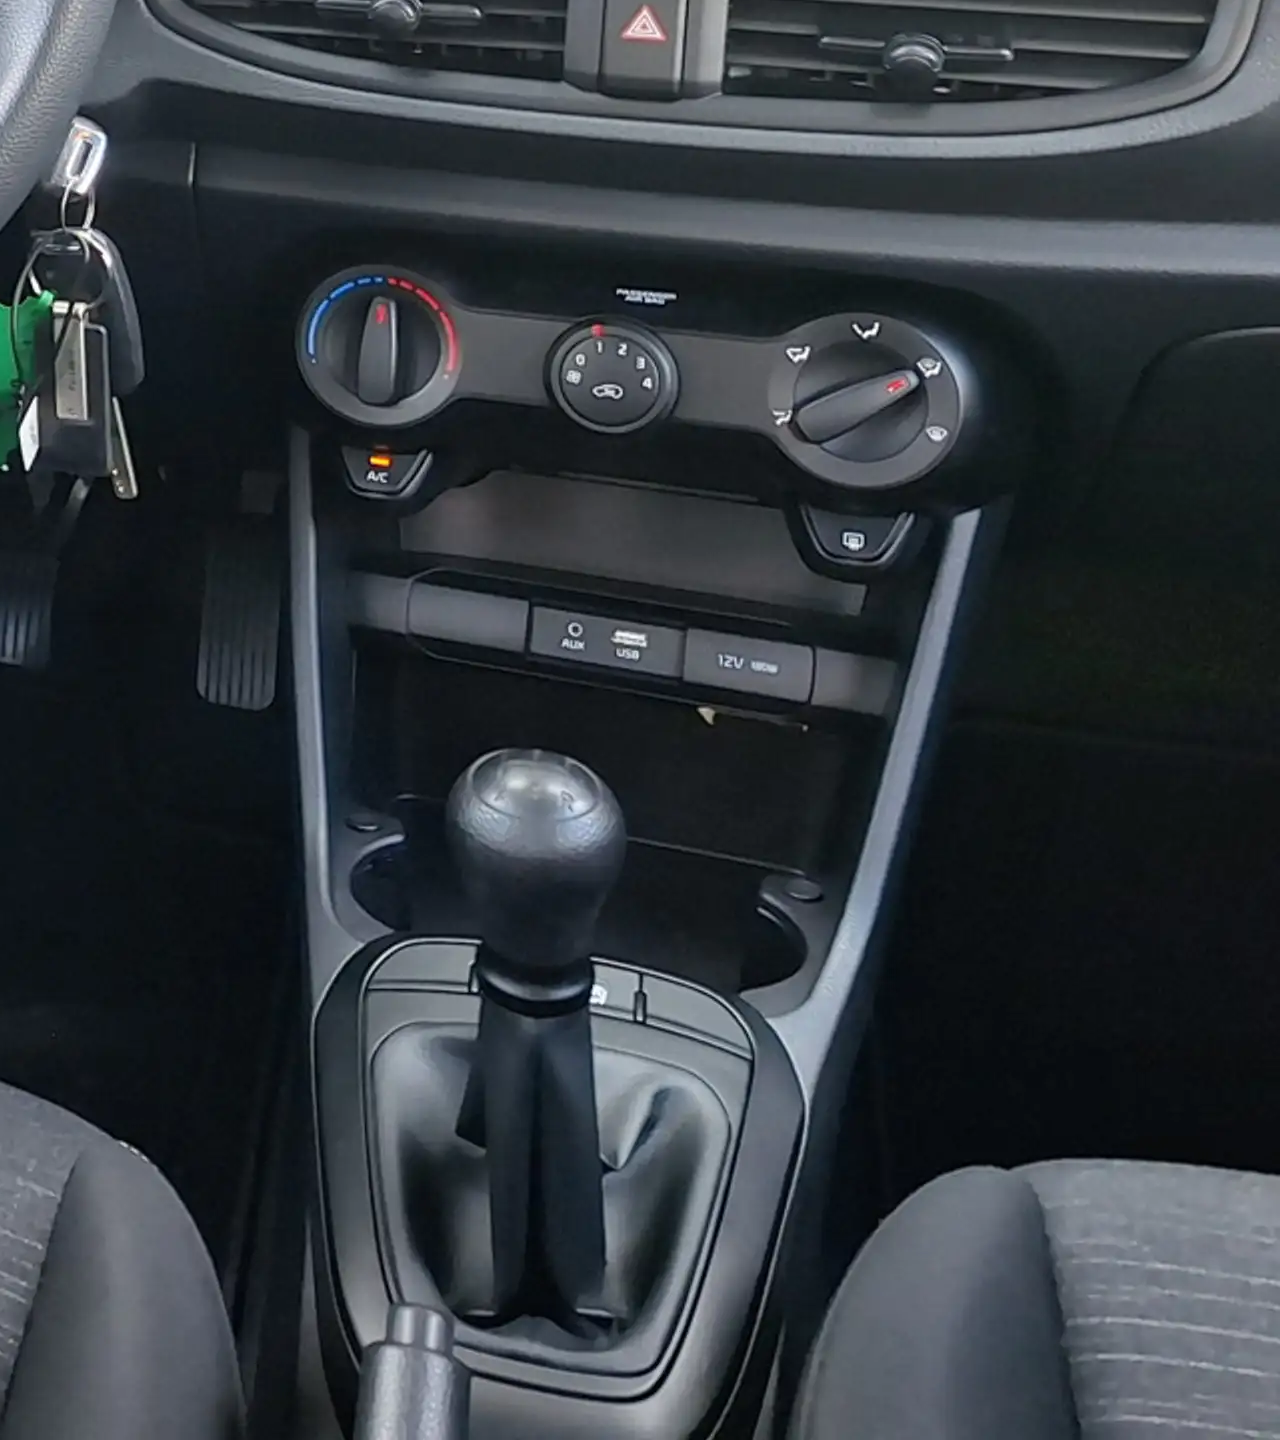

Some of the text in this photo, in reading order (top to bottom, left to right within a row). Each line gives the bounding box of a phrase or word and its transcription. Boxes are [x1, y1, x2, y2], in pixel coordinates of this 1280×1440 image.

[596, 341, 604, 353] 1
[617, 343, 628, 356] 2
[575, 353, 586, 366] 0
[636, 356, 646, 370] 3
[642, 377, 653, 390] 4
[366, 470, 389, 484] A/C
[561, 638, 585, 650] AUX
[616, 648, 640, 661] USB
[717, 653, 744, 670] 12V
